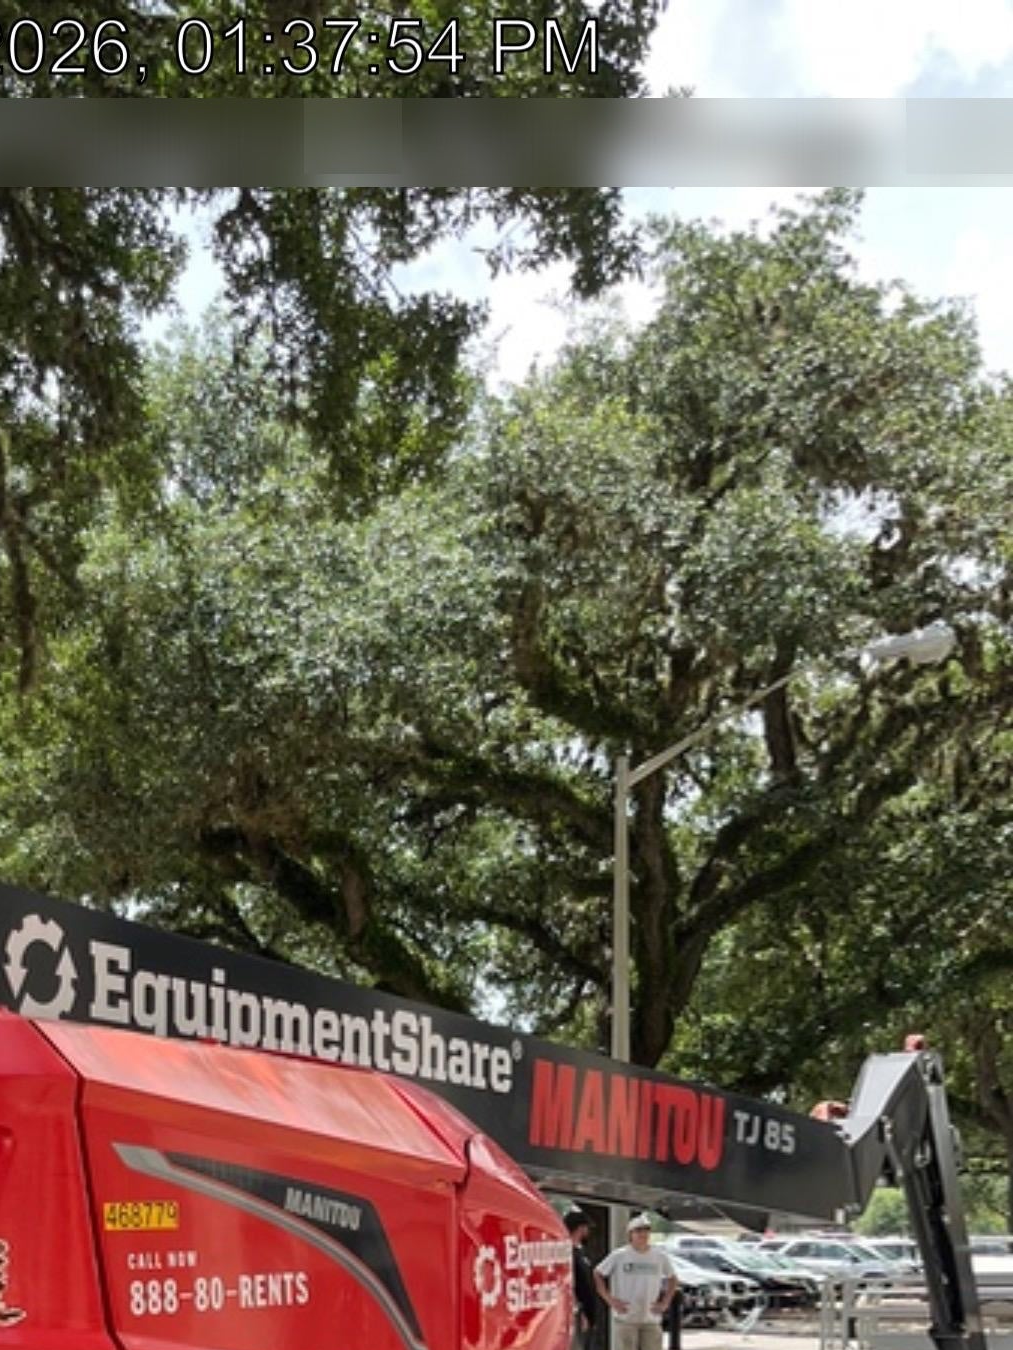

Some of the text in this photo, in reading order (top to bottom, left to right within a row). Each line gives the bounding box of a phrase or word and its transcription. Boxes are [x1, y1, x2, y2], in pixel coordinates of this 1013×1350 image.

[528, 1058, 725, 1171] MANITOU
[733, 1110, 795, 1154] TJ 85
[285, 1188, 362, 1230] MANITOU
[127, 1250, 198, 1270] CALL NOW
[129, 1271, 310, 1316] 888-80-RENTS
